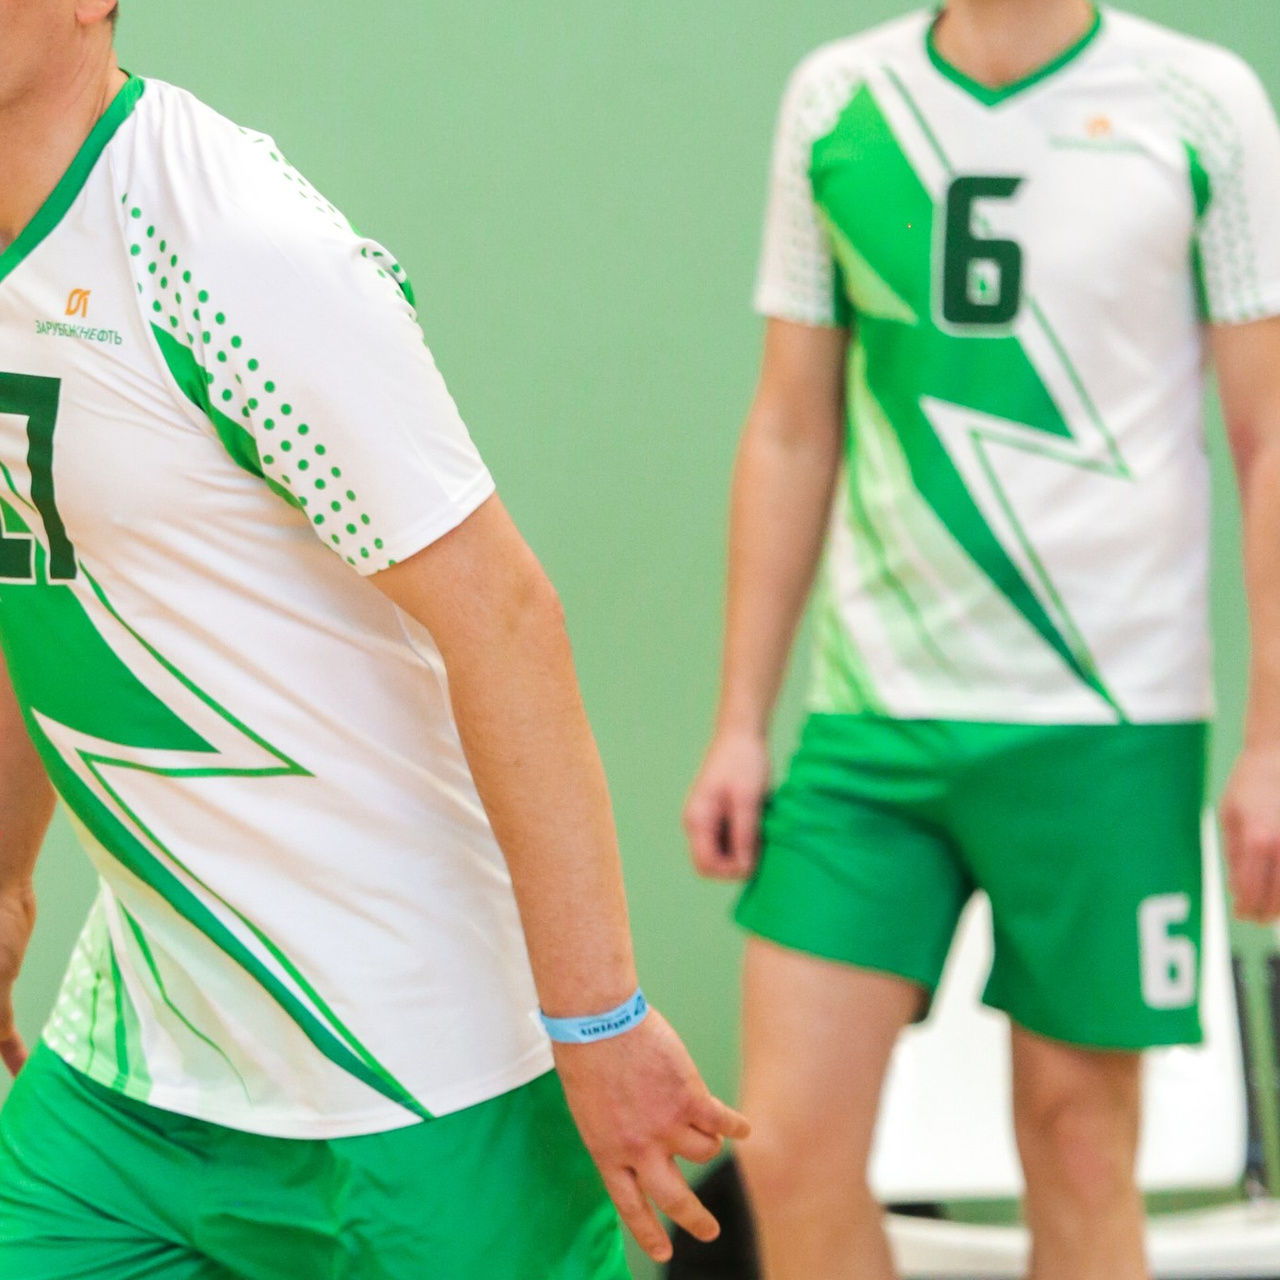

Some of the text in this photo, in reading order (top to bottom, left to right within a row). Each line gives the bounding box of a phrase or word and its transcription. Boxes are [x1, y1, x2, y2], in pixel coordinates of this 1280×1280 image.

[942, 175, 1028, 325] 6
[35, 319, 123, 345] ЗАРУБЕЖНЕФТЬ
[1137, 891, 1198, 1010] 6
